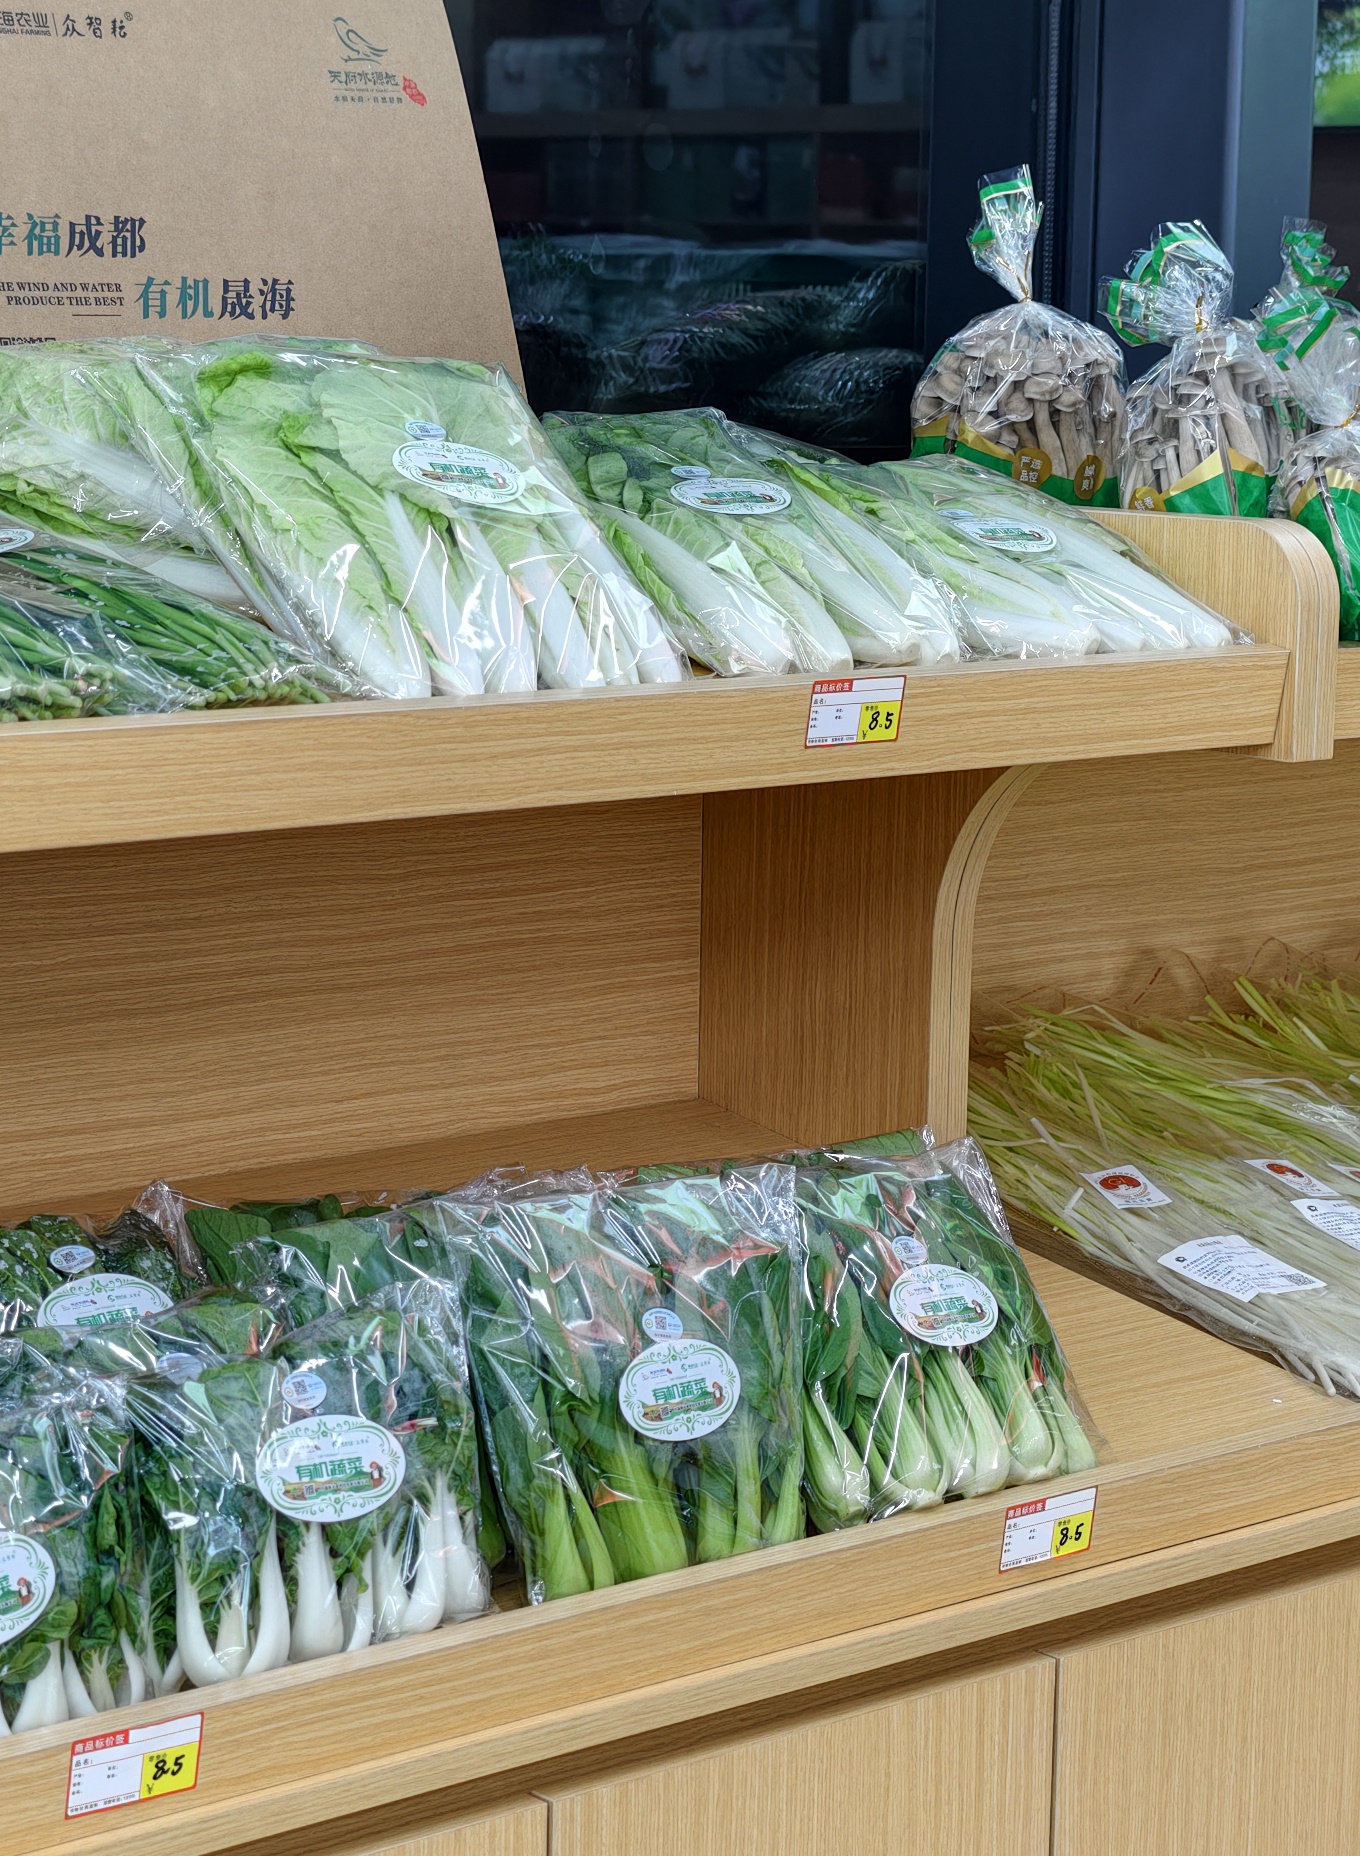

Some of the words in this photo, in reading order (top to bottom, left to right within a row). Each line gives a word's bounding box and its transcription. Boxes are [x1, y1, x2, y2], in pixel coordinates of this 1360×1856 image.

[16, 282, 50, 293] WIND
[53, 282, 78, 293] AND
[79, 282, 123, 293] WATER
[6, 295, 65, 306] PRODUCE
[66, 296, 92, 306] THE
[94, 296, 125, 307] BEST
[134, 276, 296, 320] 有机晟海
[1020, 470, 1039, 483] 品控
[869, 711, 894, 730] 8.5
[919, 1296, 968, 1315] 有机蔬菜
[652, 1378, 708, 1403] 有机蔬菜
[295, 1457, 364, 1481] 有机蔬菜
[1059, 1523, 1084, 1546] 8.5
[74, 1733, 125, 1754] 商品标价签
